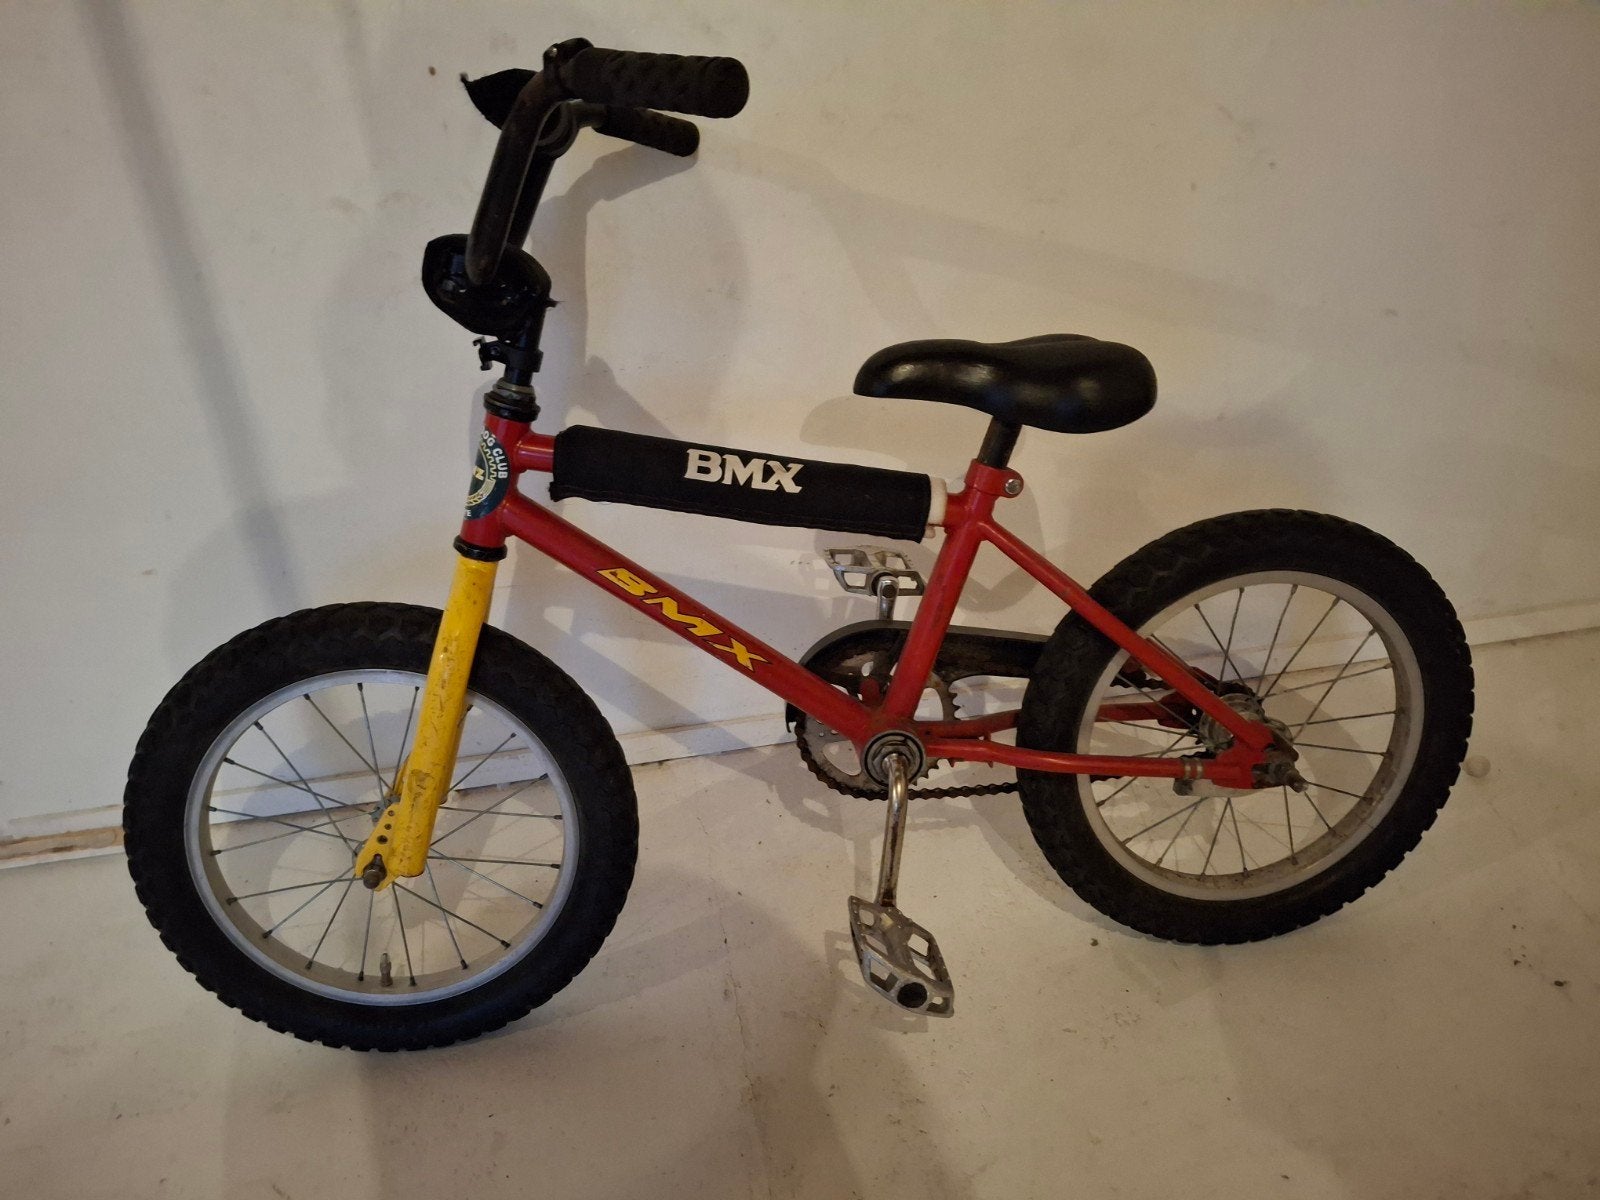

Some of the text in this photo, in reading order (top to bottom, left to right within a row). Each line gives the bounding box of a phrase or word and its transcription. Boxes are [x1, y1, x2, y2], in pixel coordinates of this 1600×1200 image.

[492, 447, 509, 479] CLUB
[684, 448, 805, 493] BMX
[596, 567, 770, 672] BMX
